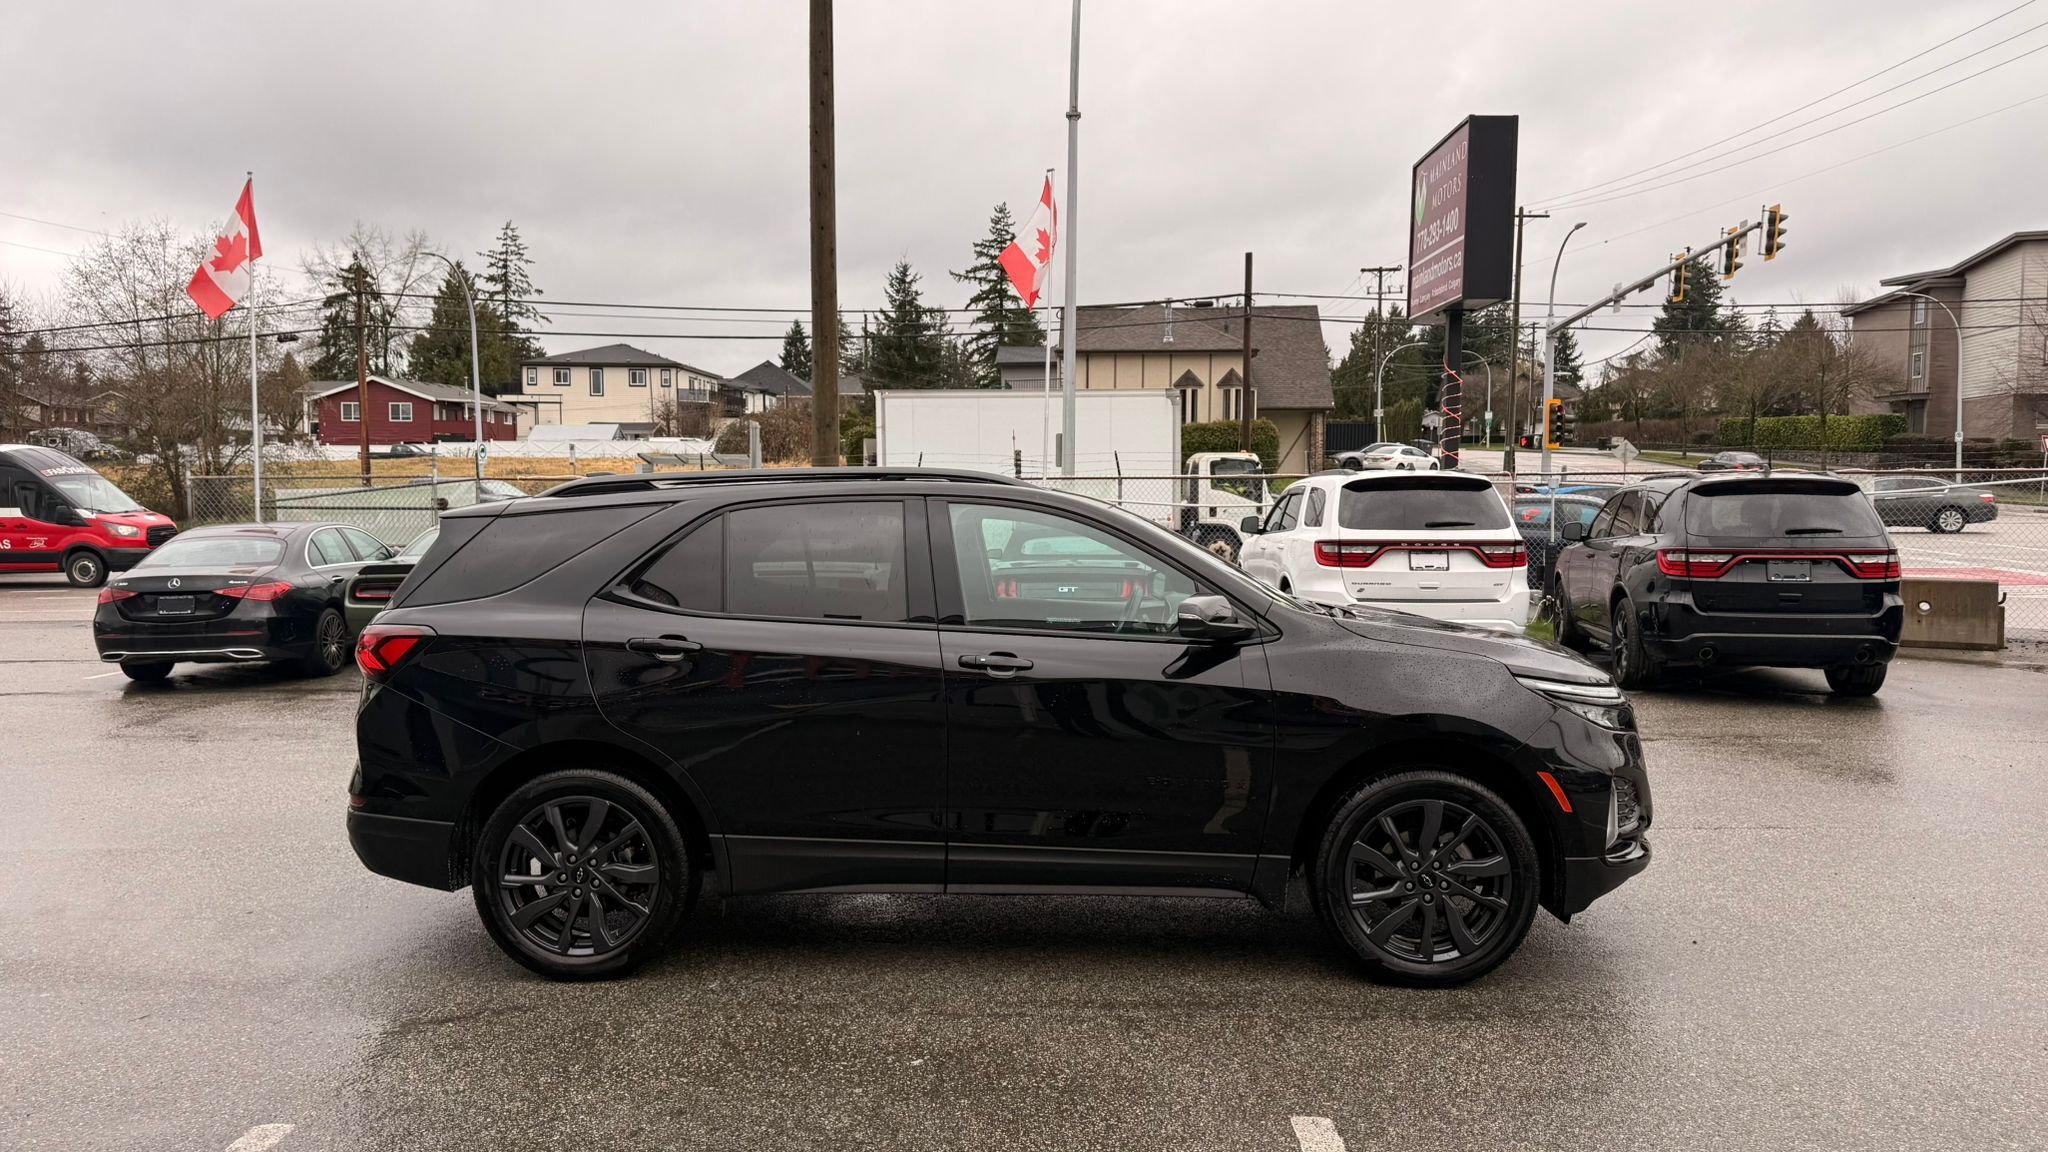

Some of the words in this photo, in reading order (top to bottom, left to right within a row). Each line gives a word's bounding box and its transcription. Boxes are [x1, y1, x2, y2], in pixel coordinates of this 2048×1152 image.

[1430, 141, 1467, 182] MAINLAND
[1432, 172, 1461, 210] MOTORS
[1416, 207, 1459, 254] 778-293-1400
[1412, 251, 1462, 290] mainlandmotors.ca
